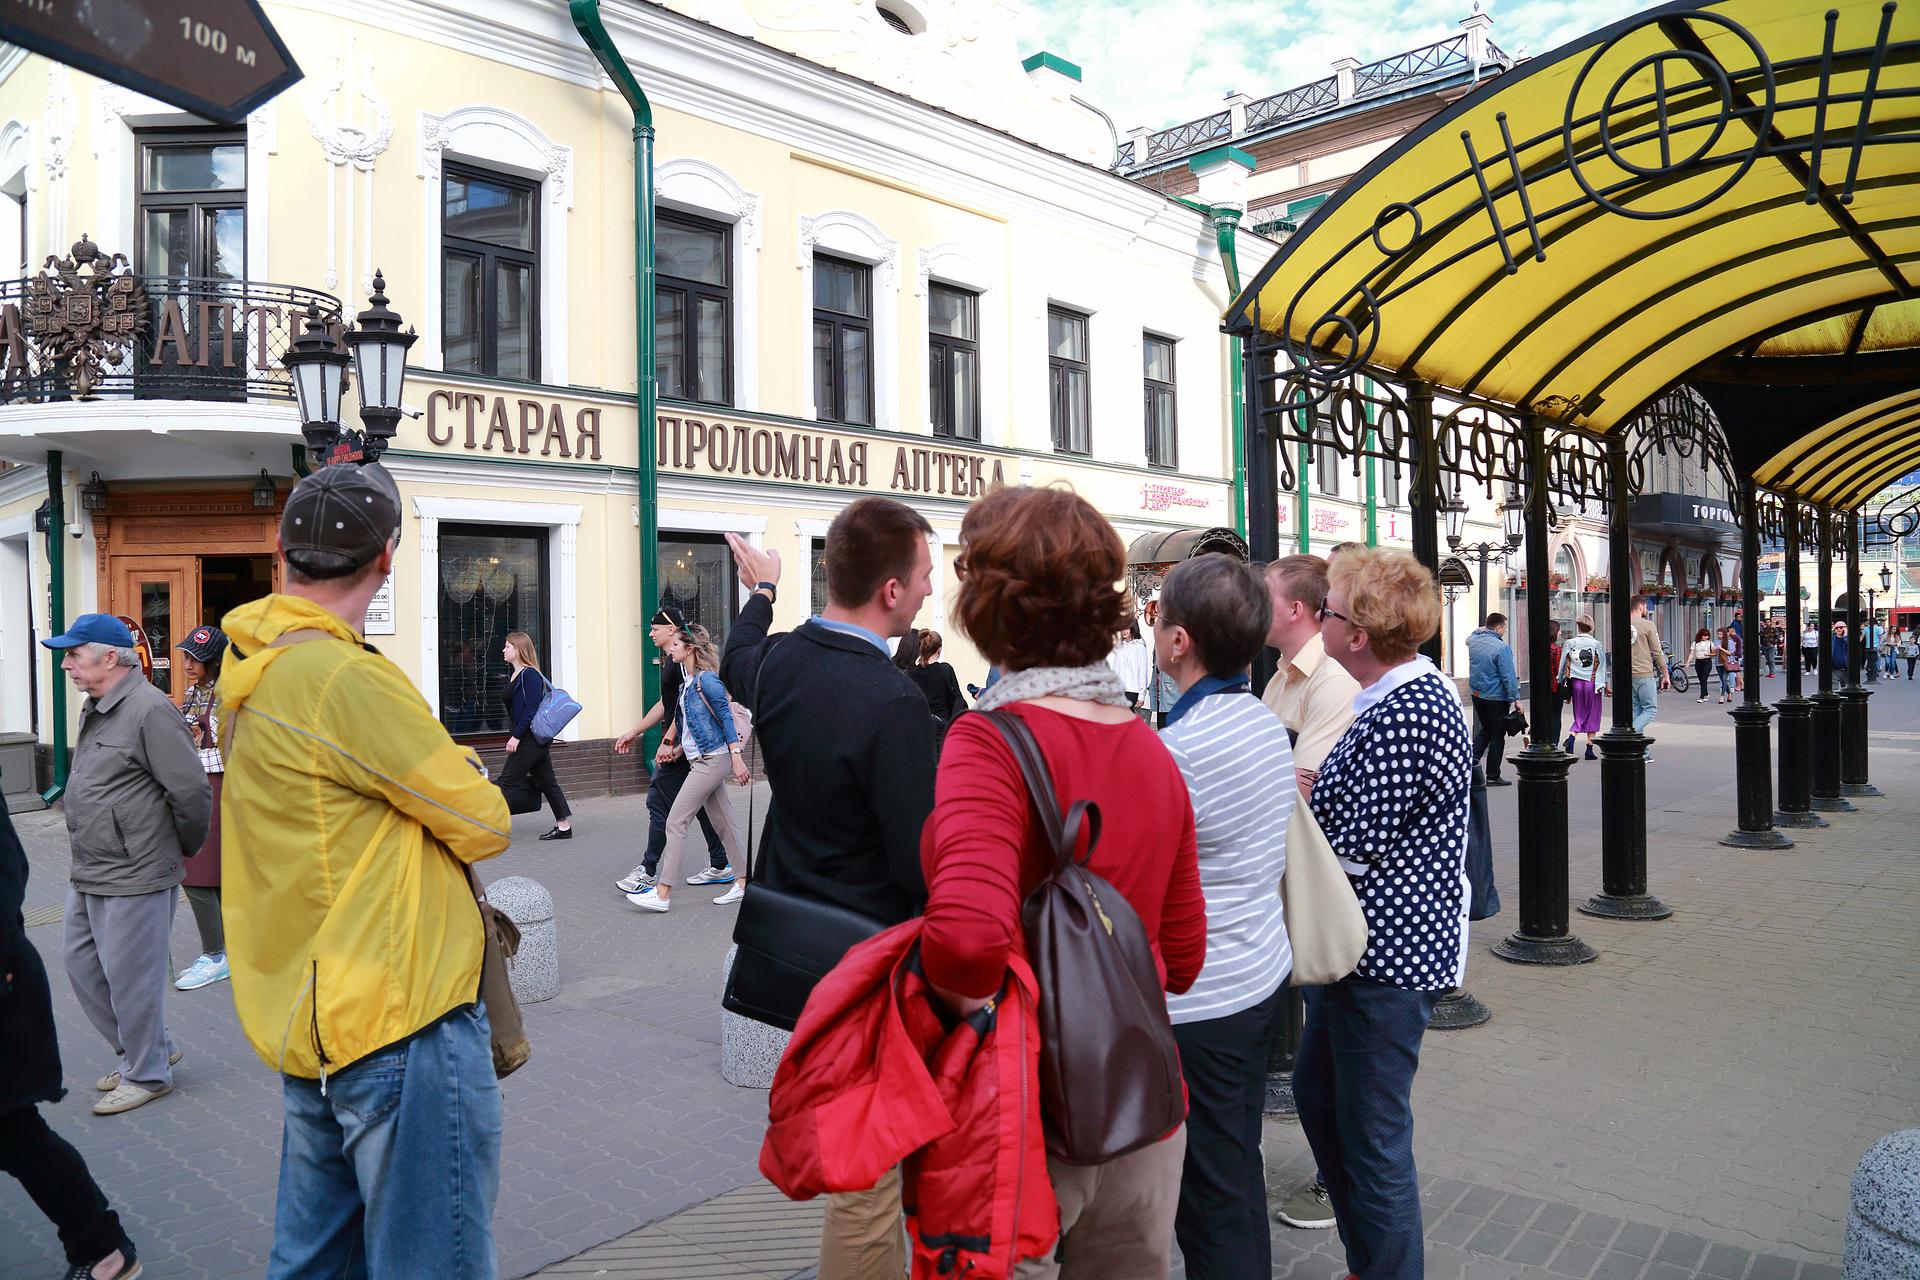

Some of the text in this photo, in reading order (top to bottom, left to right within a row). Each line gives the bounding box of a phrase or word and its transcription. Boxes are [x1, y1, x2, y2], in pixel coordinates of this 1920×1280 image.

[179, 16, 227, 54] 100
[427, 389, 602, 459] СТАРАЯ
[657, 415, 1005, 497] ПРОЛОМНАЯ АПТЕКА
[1692, 504, 1742, 525] ТОРГОВ
